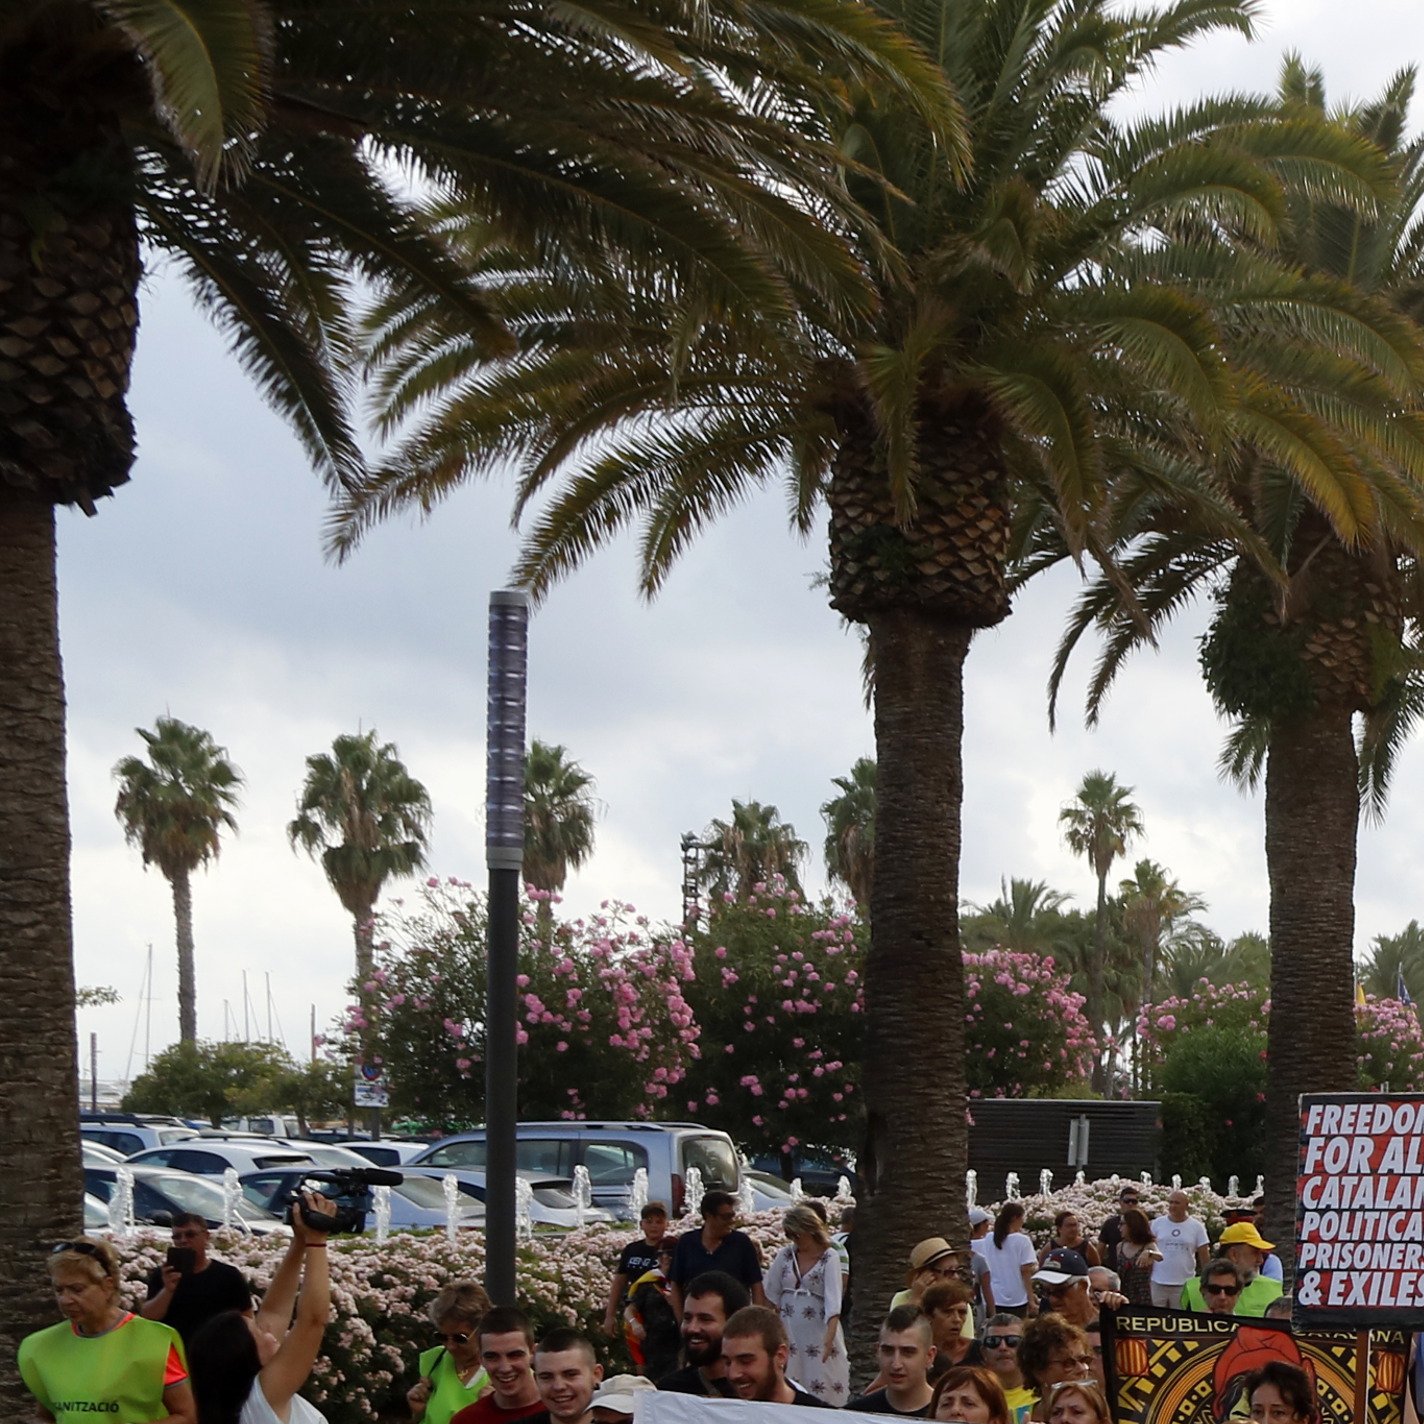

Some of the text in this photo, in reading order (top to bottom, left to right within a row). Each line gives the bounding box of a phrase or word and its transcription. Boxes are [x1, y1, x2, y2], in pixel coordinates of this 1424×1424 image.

[1303, 1136, 1375, 1174] FOR
[1298, 1270, 1322, 1306] &
[55, 1400, 120, 1413] ANITZACIÓ
